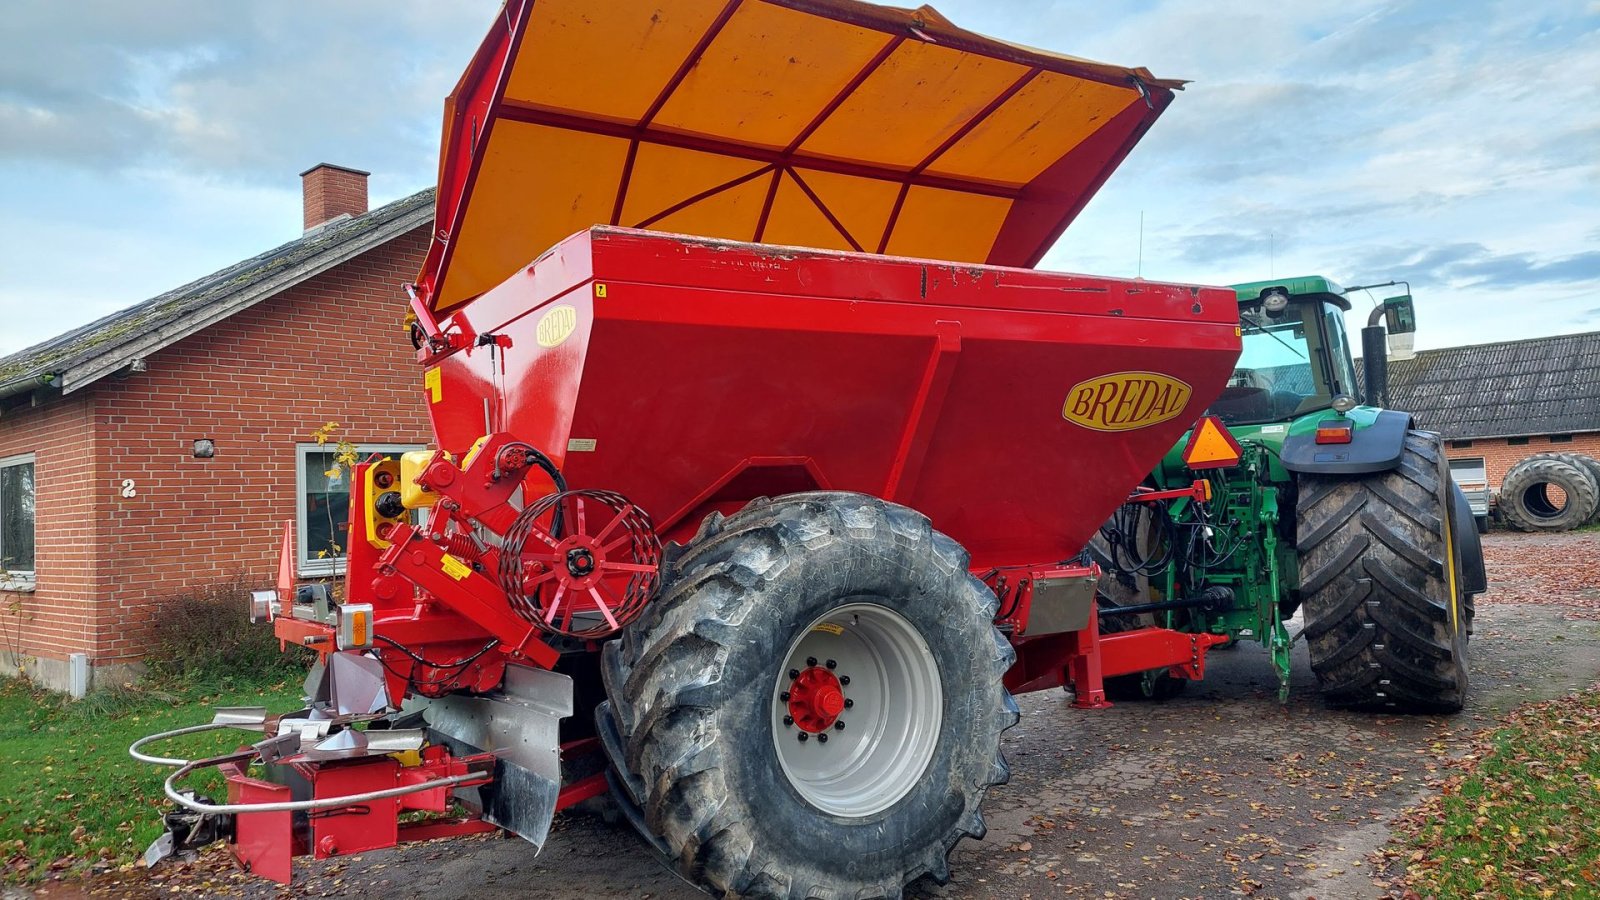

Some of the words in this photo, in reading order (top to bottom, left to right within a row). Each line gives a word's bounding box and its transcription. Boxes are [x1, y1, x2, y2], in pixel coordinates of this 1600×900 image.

[539, 309, 573, 344] BREDAL
[1071, 379, 1184, 426] BREDAL
[122, 479, 136, 498] 2
